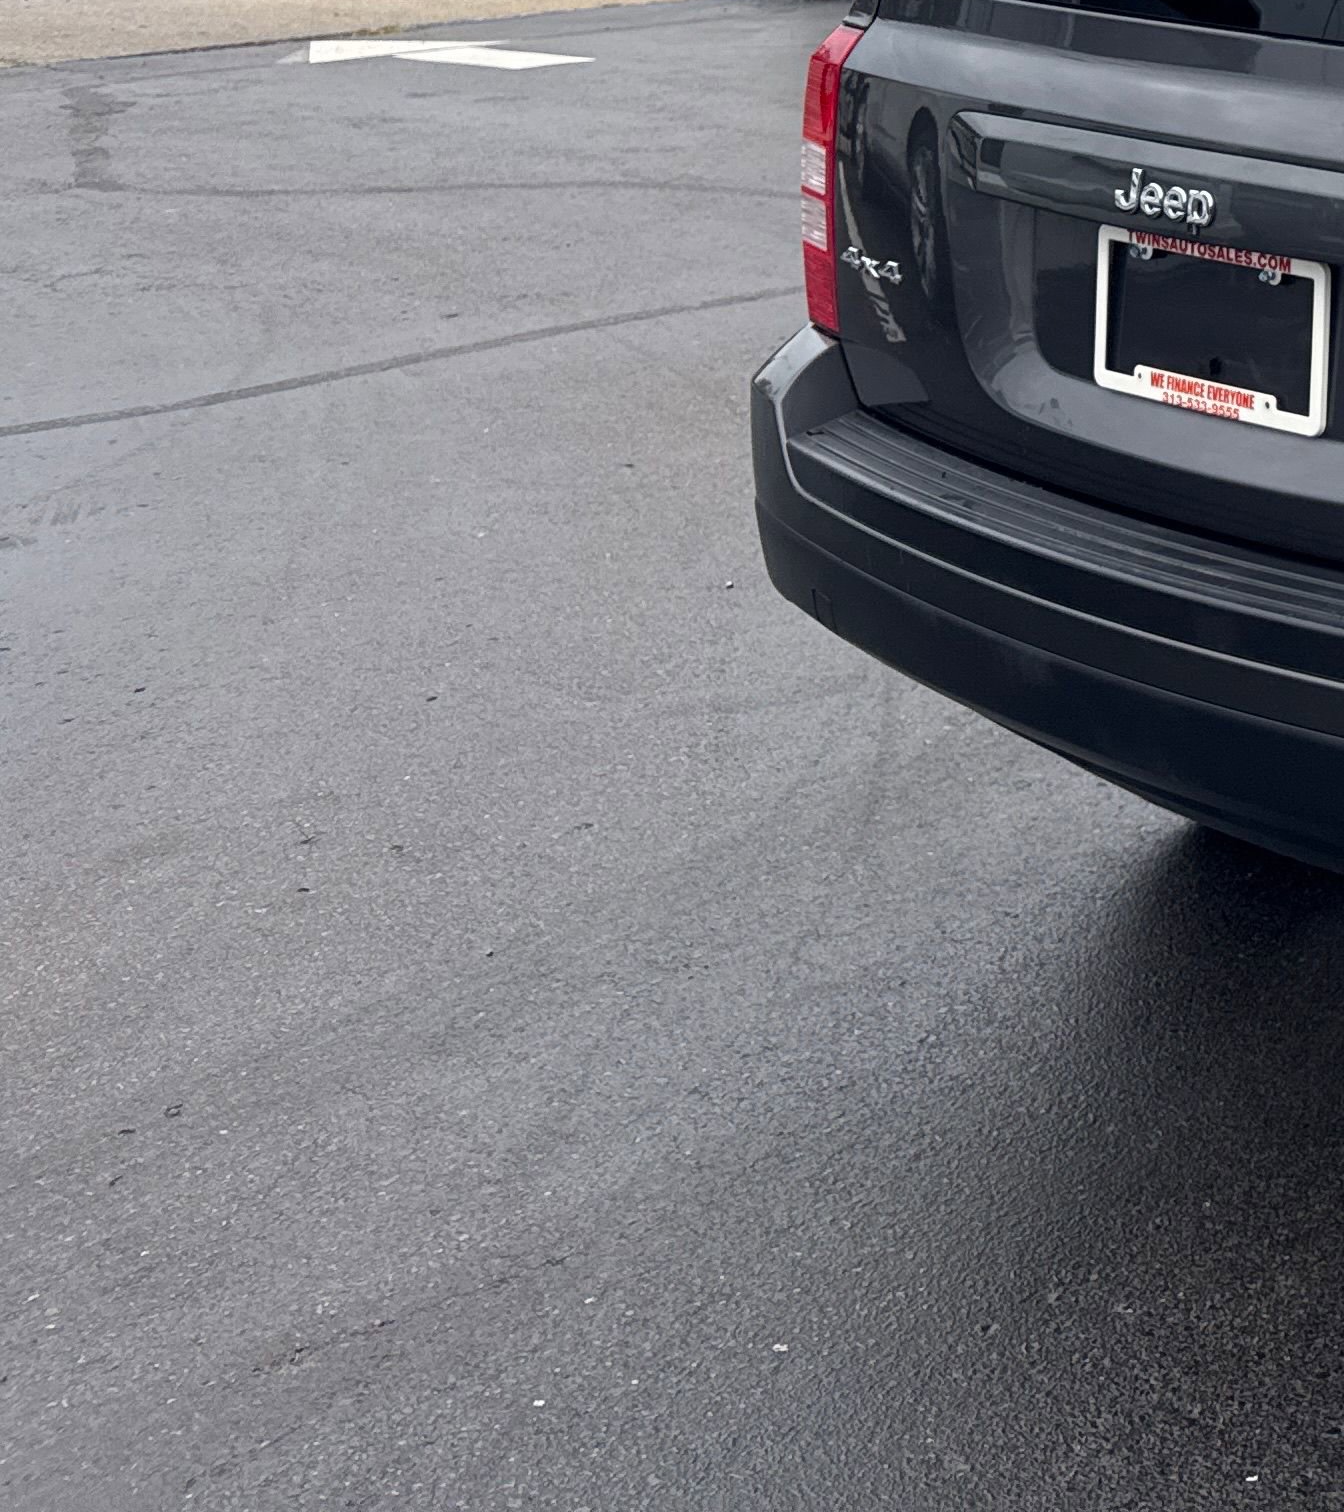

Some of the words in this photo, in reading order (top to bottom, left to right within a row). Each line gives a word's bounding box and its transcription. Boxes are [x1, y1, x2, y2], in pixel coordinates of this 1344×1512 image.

[1115, 168, 1216, 235] Jeep
[1127, 229, 1292, 273] TWINSAUTOSALES.COM
[1150, 371, 1165, 388] WE
[1166, 375, 1206, 397] FINANCE
[1207, 386, 1255, 410] EVERYONE
[1162, 391, 1240, 420] 313-533-9555
